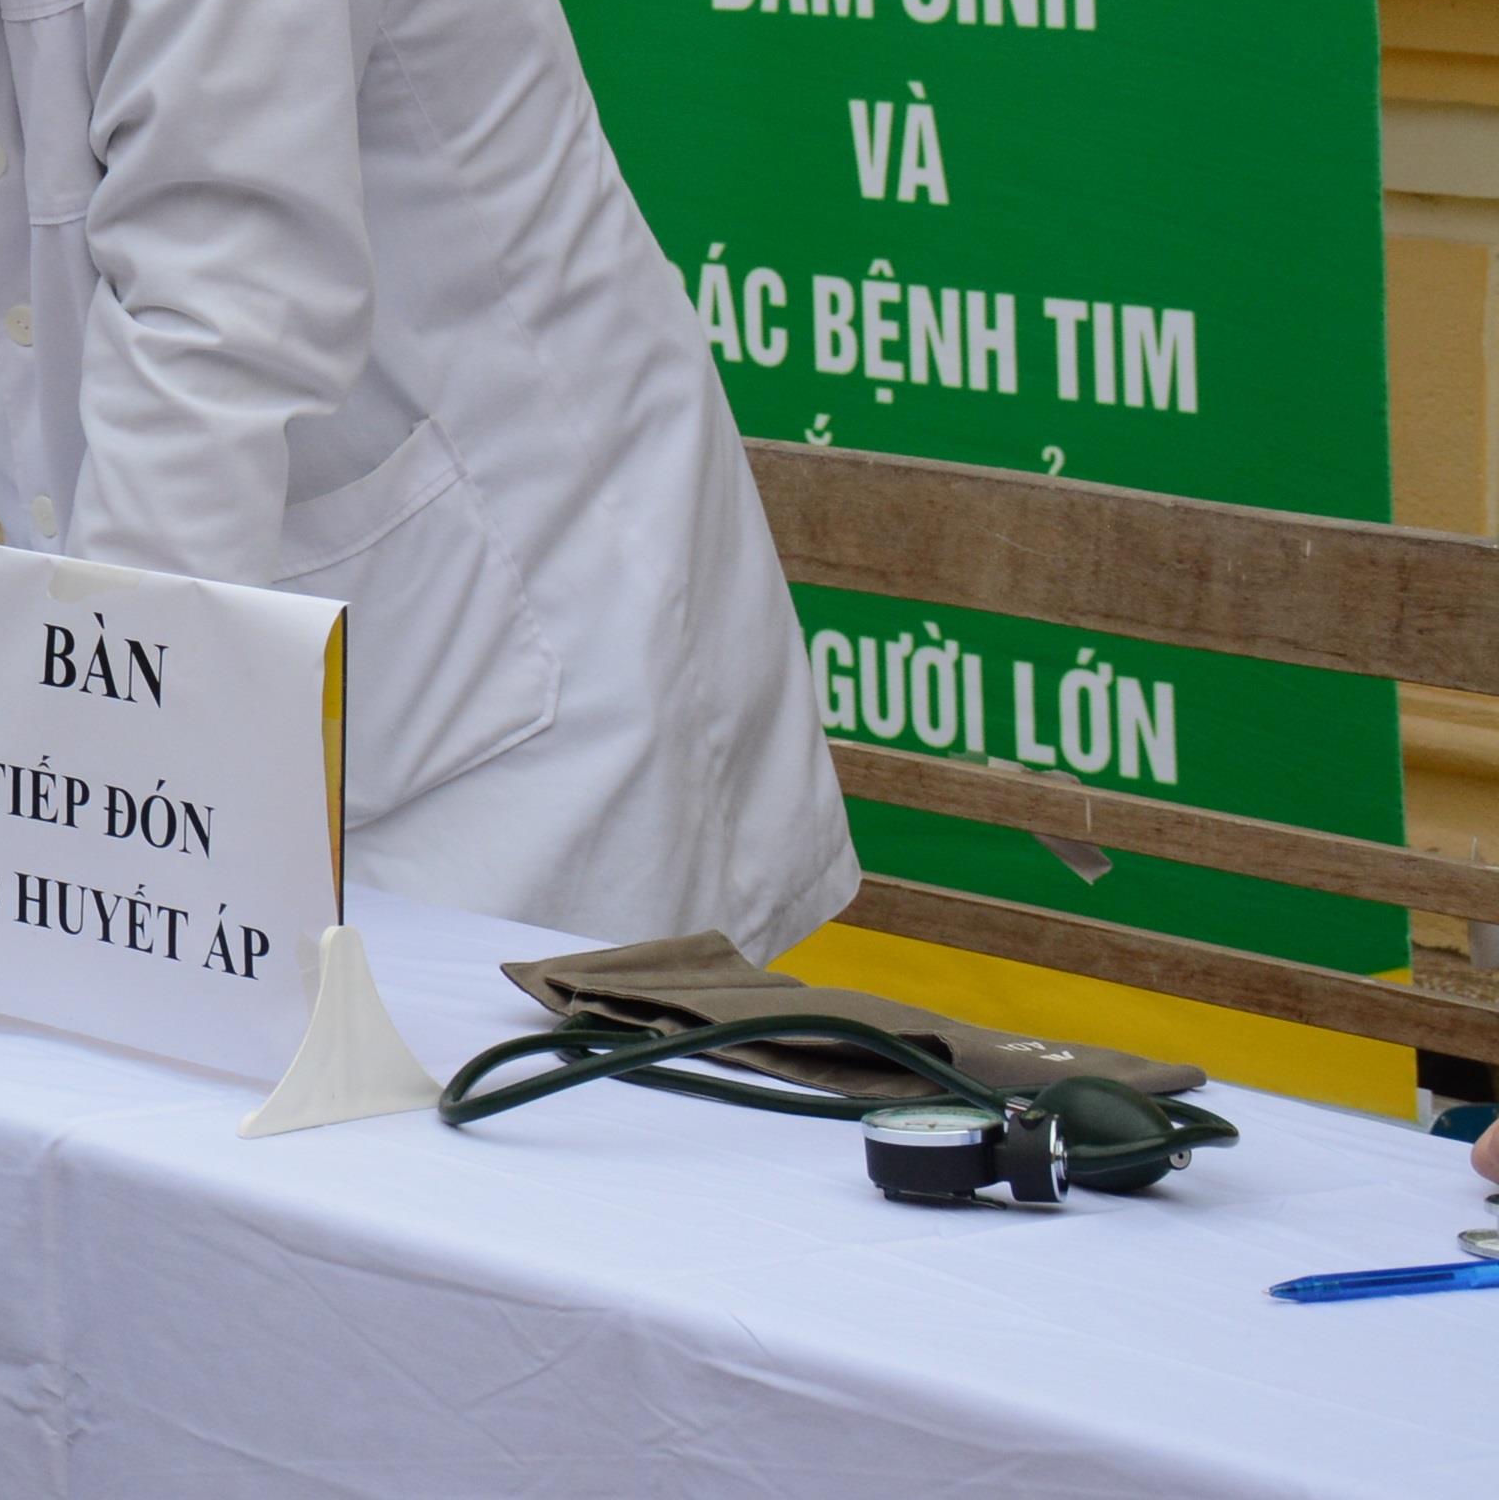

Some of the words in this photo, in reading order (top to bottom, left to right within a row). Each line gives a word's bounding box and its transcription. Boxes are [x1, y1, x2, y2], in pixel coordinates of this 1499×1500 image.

[848, 79, 949, 205] VÀ
[667, 241, 789, 367] ÁC
[812, 258, 1018, 404] BỆNH
[1043, 296, 1198, 414] TIM
[39, 611, 169, 709] BÀN
[801, 621, 985, 751] GƯỜI
[1013, 648, 1178, 785] LỚN
[102, 779, 215, 859] ĐÓN
[13, 871, 189, 962] HUYẾT
[202, 903, 271, 981] ÁP
